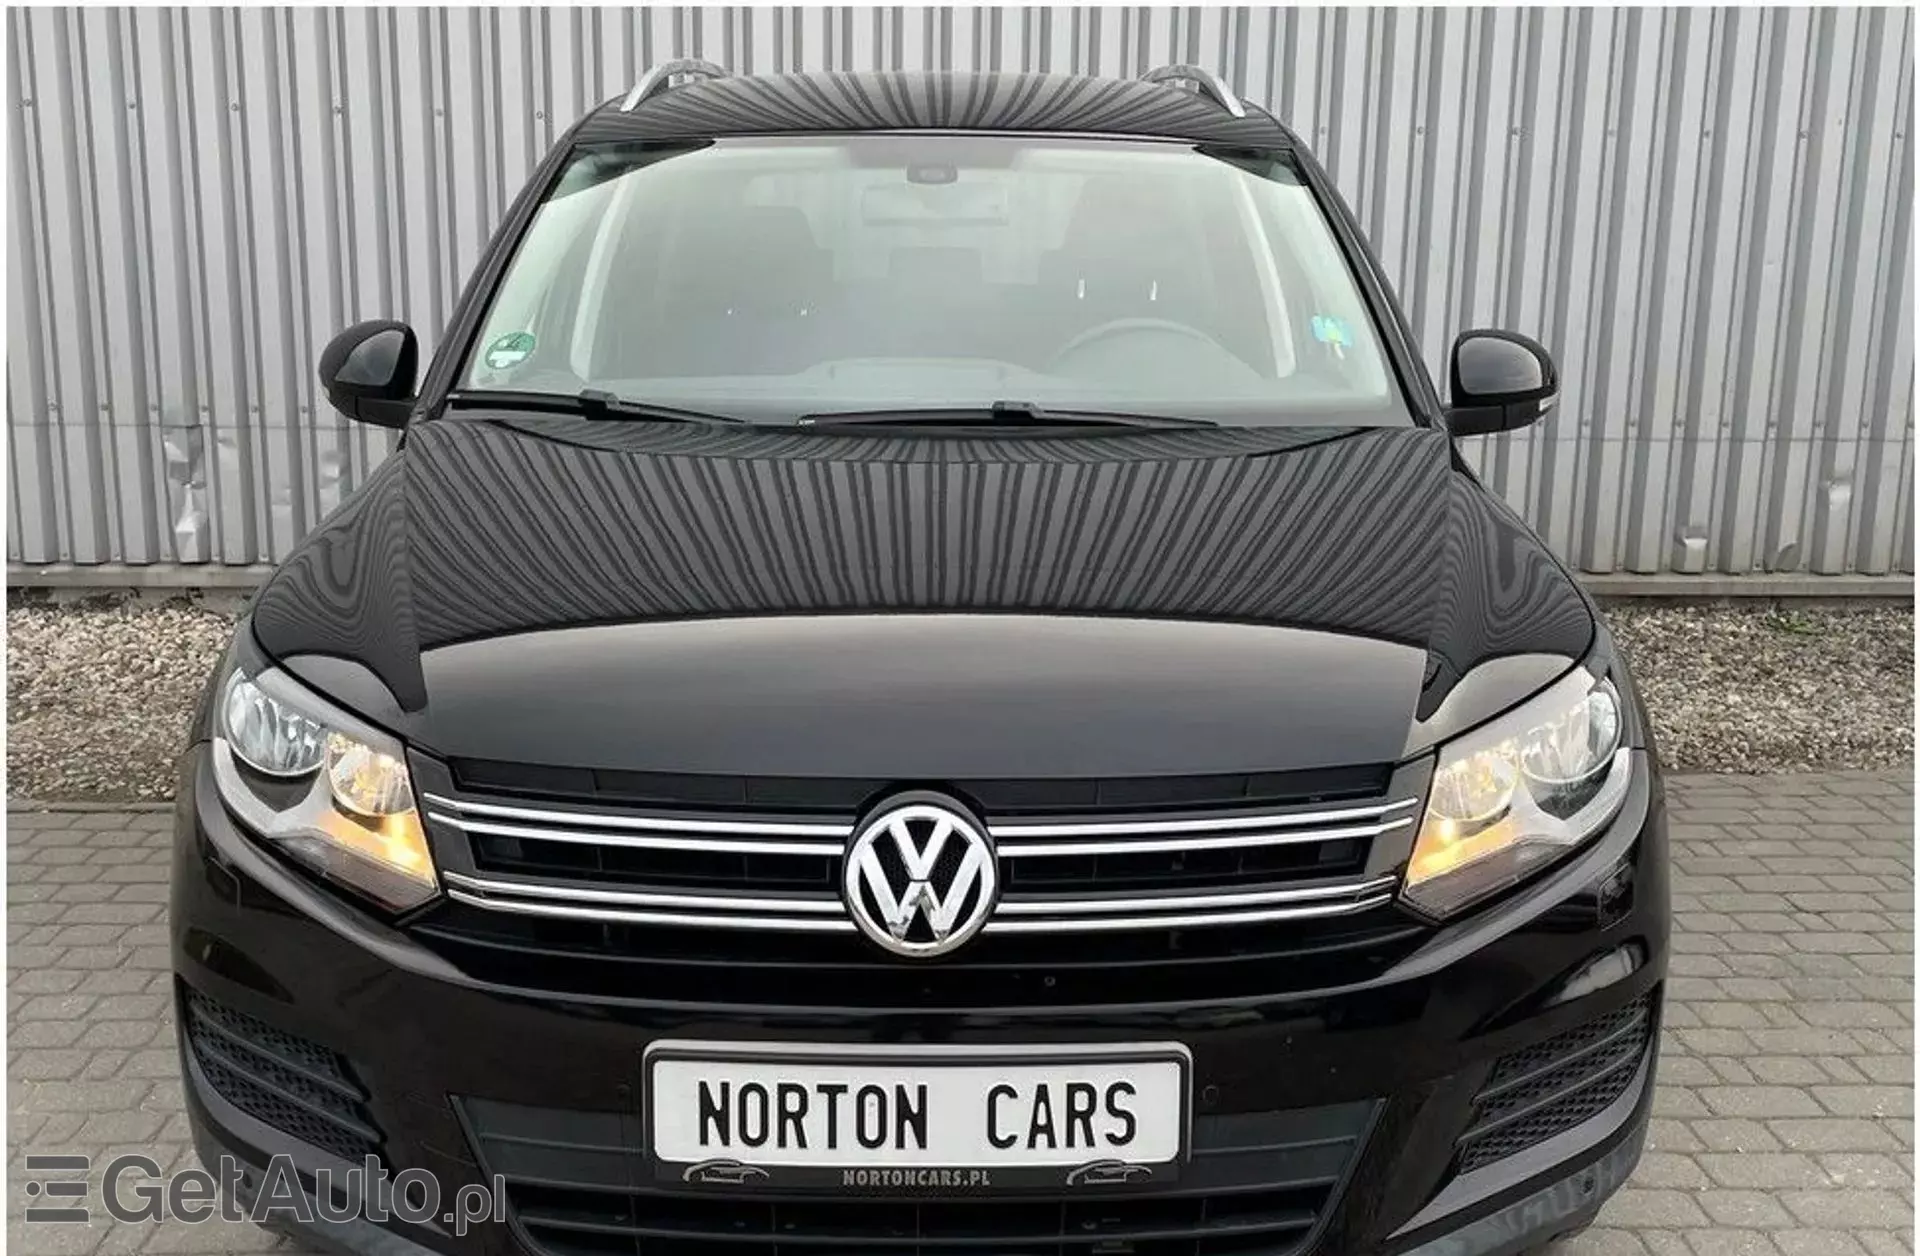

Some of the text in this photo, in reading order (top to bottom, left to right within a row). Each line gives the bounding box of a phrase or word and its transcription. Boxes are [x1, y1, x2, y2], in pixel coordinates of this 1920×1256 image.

[852, 810, 990, 950] VW
[698, 1080, 1137, 1150] NORTON CARS
[843, 1169, 991, 1186] NORTONCARS.PL
